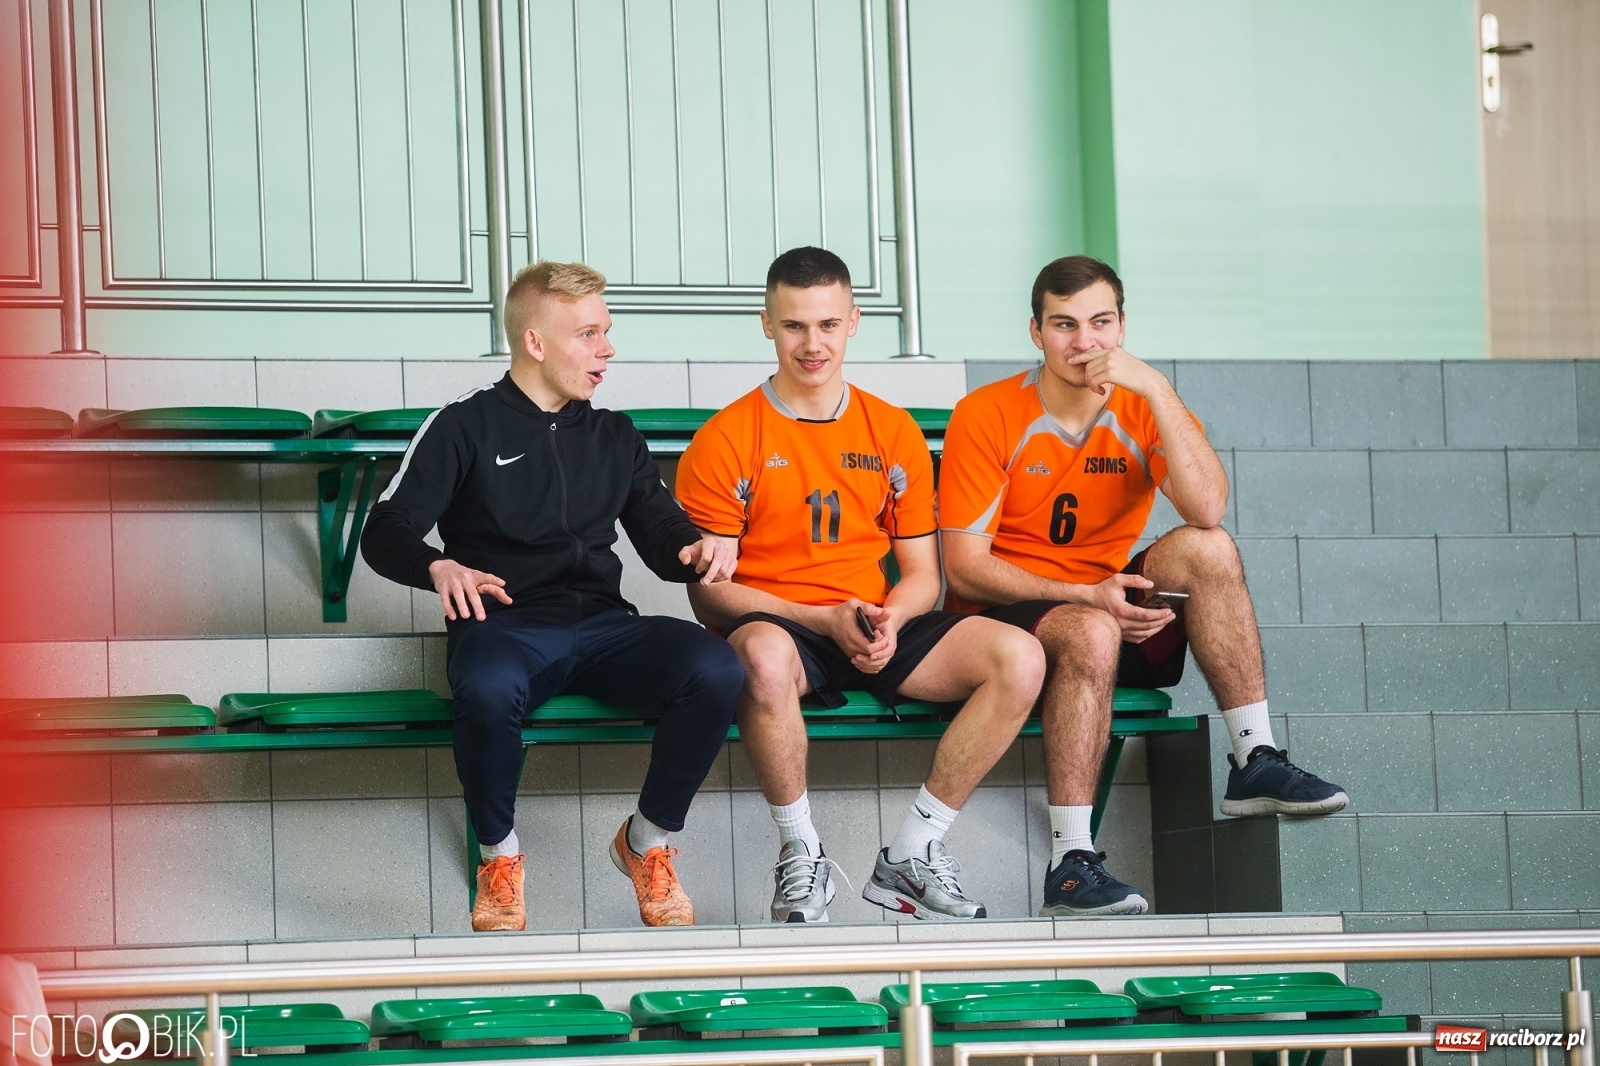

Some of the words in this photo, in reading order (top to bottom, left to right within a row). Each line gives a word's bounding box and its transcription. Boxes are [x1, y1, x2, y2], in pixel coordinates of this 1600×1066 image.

[1084, 457, 1127, 474] ZSOMS
[805, 489, 840, 542] 11
[1049, 493, 1078, 545] 6
